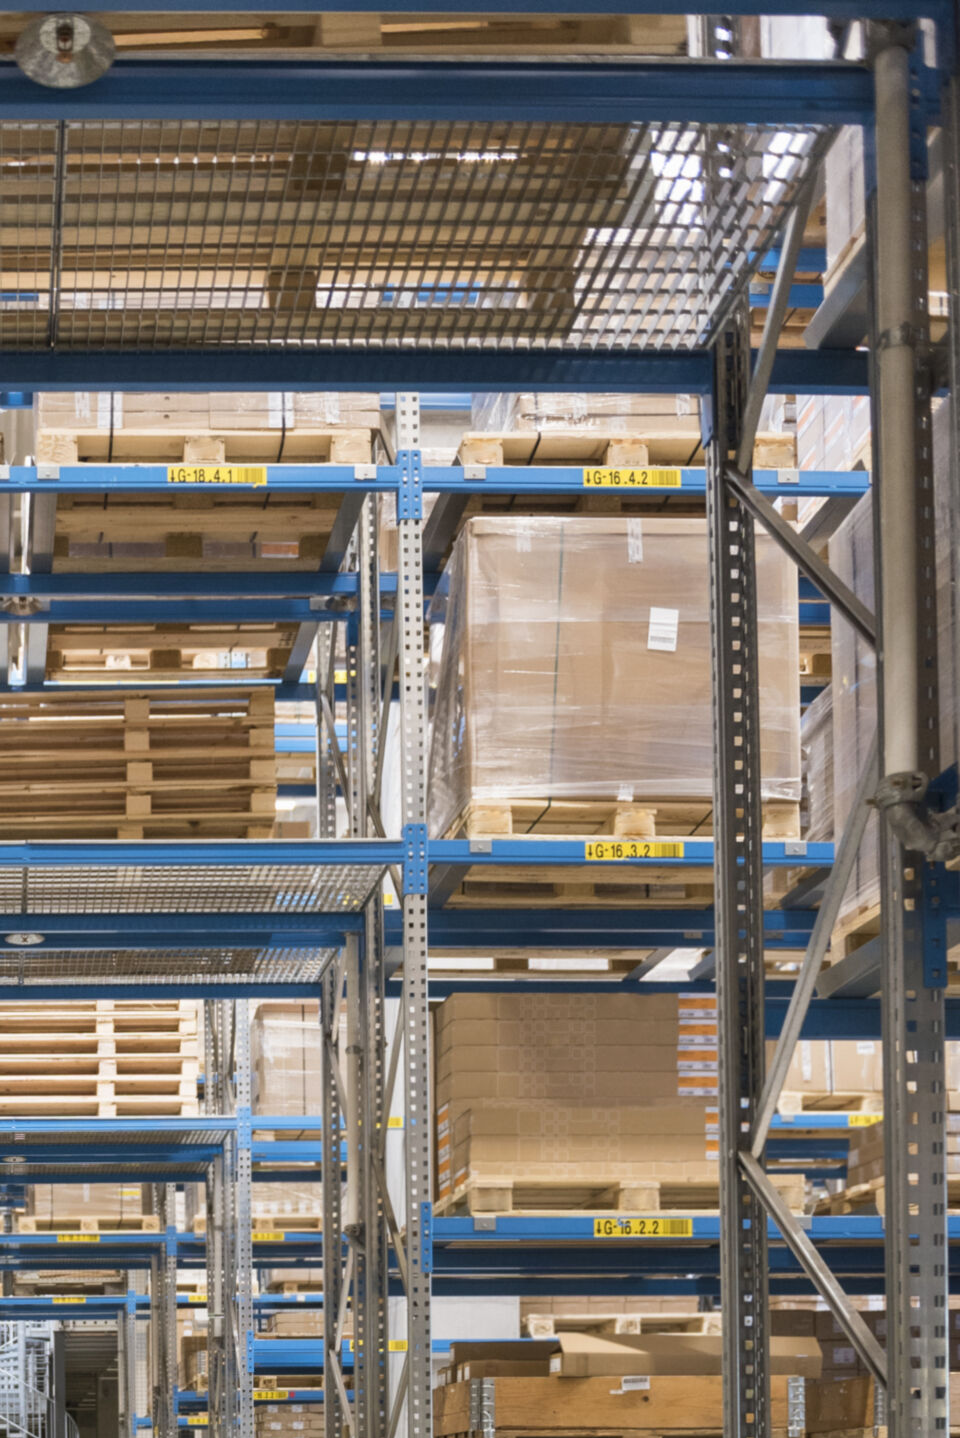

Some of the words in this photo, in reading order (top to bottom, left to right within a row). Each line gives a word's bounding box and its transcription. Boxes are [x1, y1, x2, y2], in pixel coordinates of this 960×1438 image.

[177, 469, 233, 483] G-18.4.1
[593, 470, 648, 485] G-16.4.2
[595, 843, 651, 858] G-16.3.2
[604, 1219, 660, 1235] G-16.2.2
